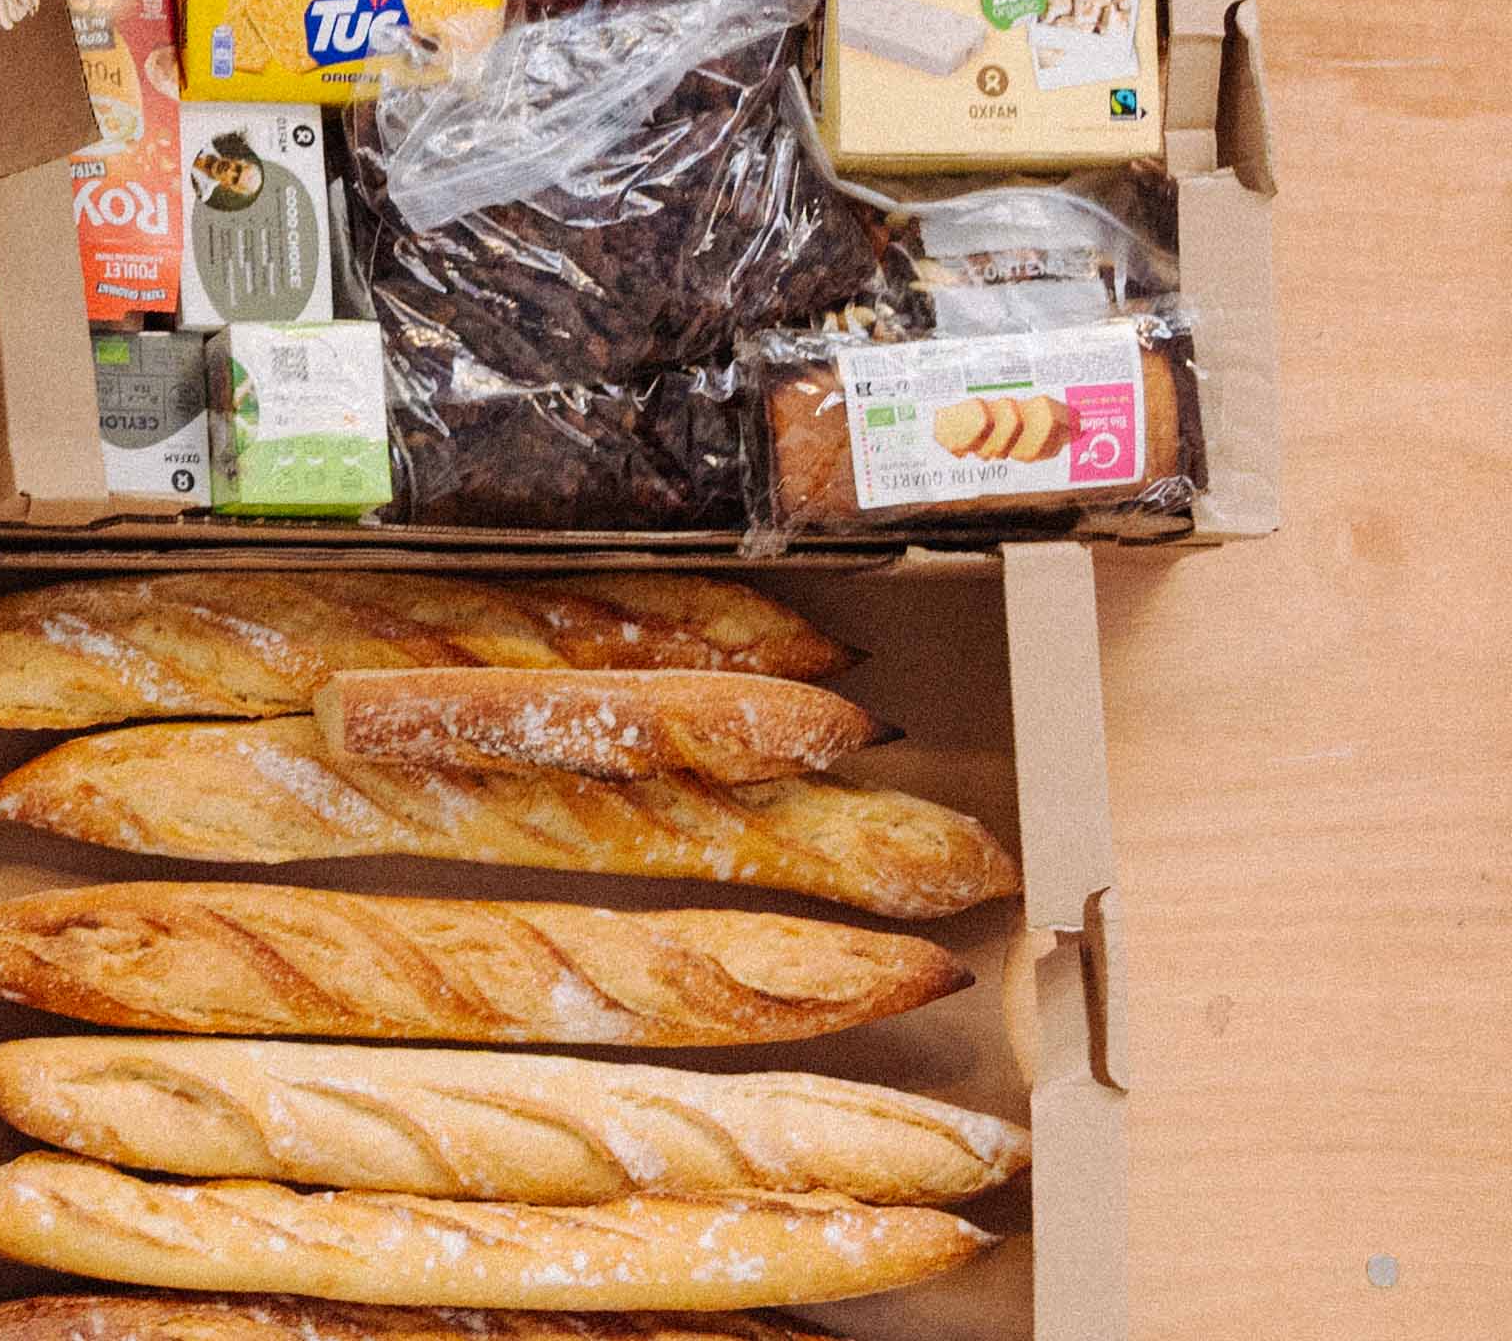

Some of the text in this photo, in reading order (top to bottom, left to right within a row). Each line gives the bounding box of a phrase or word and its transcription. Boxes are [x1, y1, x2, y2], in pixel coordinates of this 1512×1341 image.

[969, 104, 1018, 119] OXFAM
[285, 185, 302, 289] GOOD CHOICE
[104, 261, 158, 280] POULET
[164, 453, 200, 464] OXFAM
[880, 470, 943, 490] QUARTS
